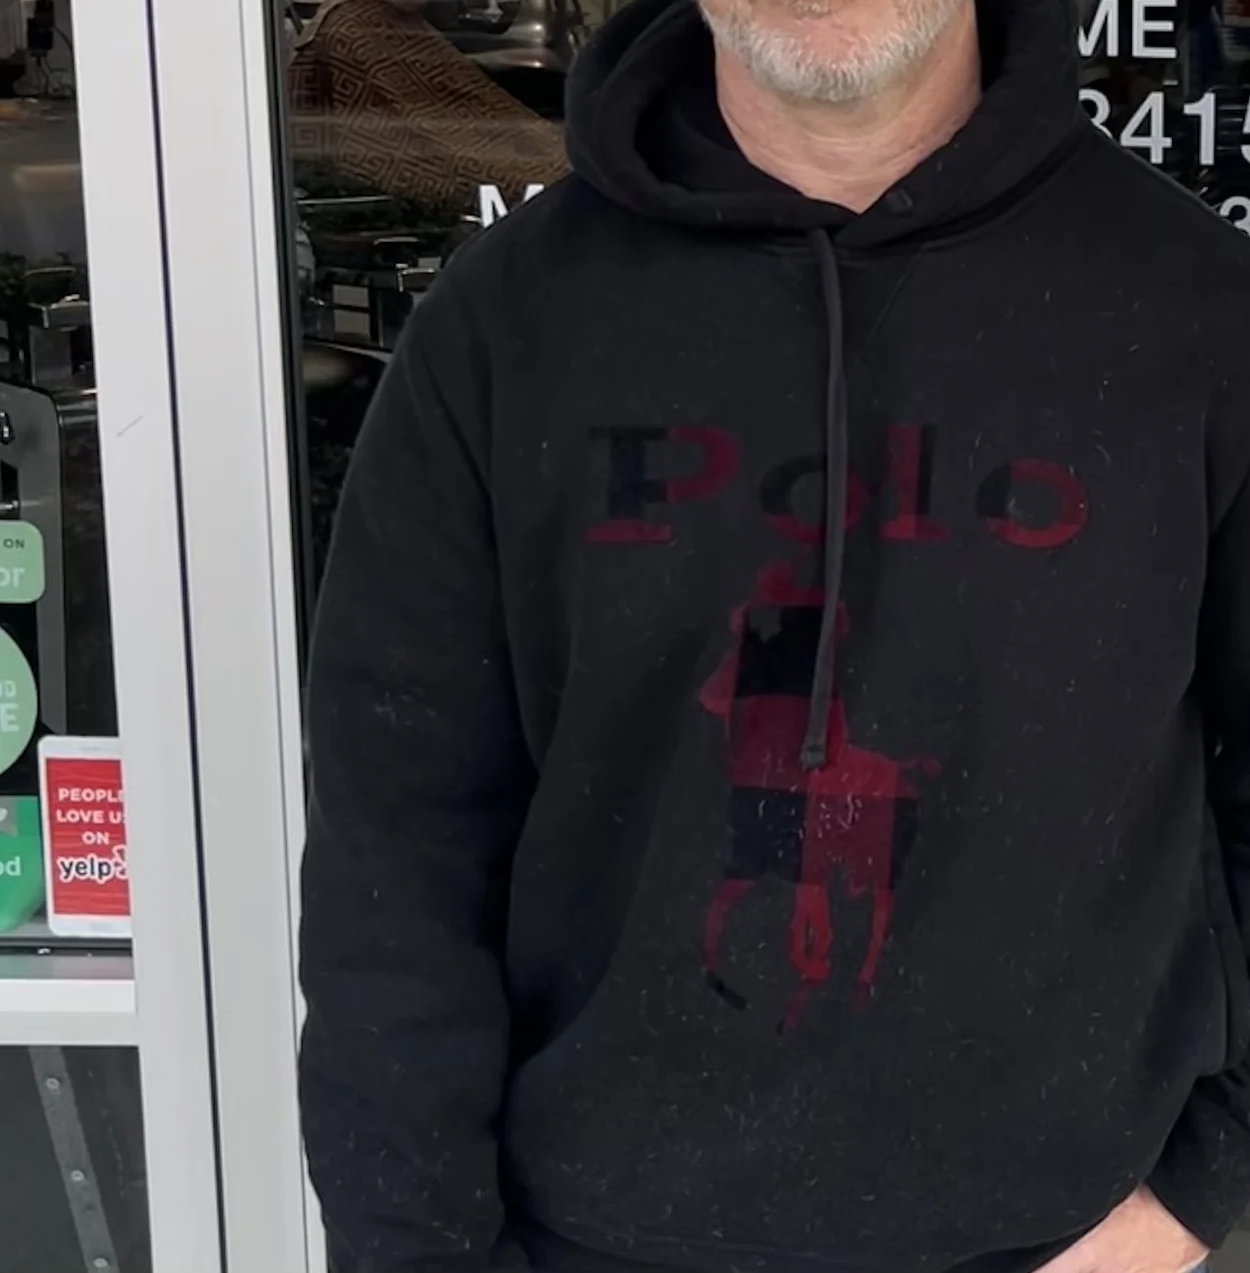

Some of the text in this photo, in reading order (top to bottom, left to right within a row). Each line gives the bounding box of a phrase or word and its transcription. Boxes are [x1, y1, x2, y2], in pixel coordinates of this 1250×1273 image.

[56, 808, 105, 824] LOVE
[82, 830, 110, 845] ON
[58, 854, 113, 883] yelp
